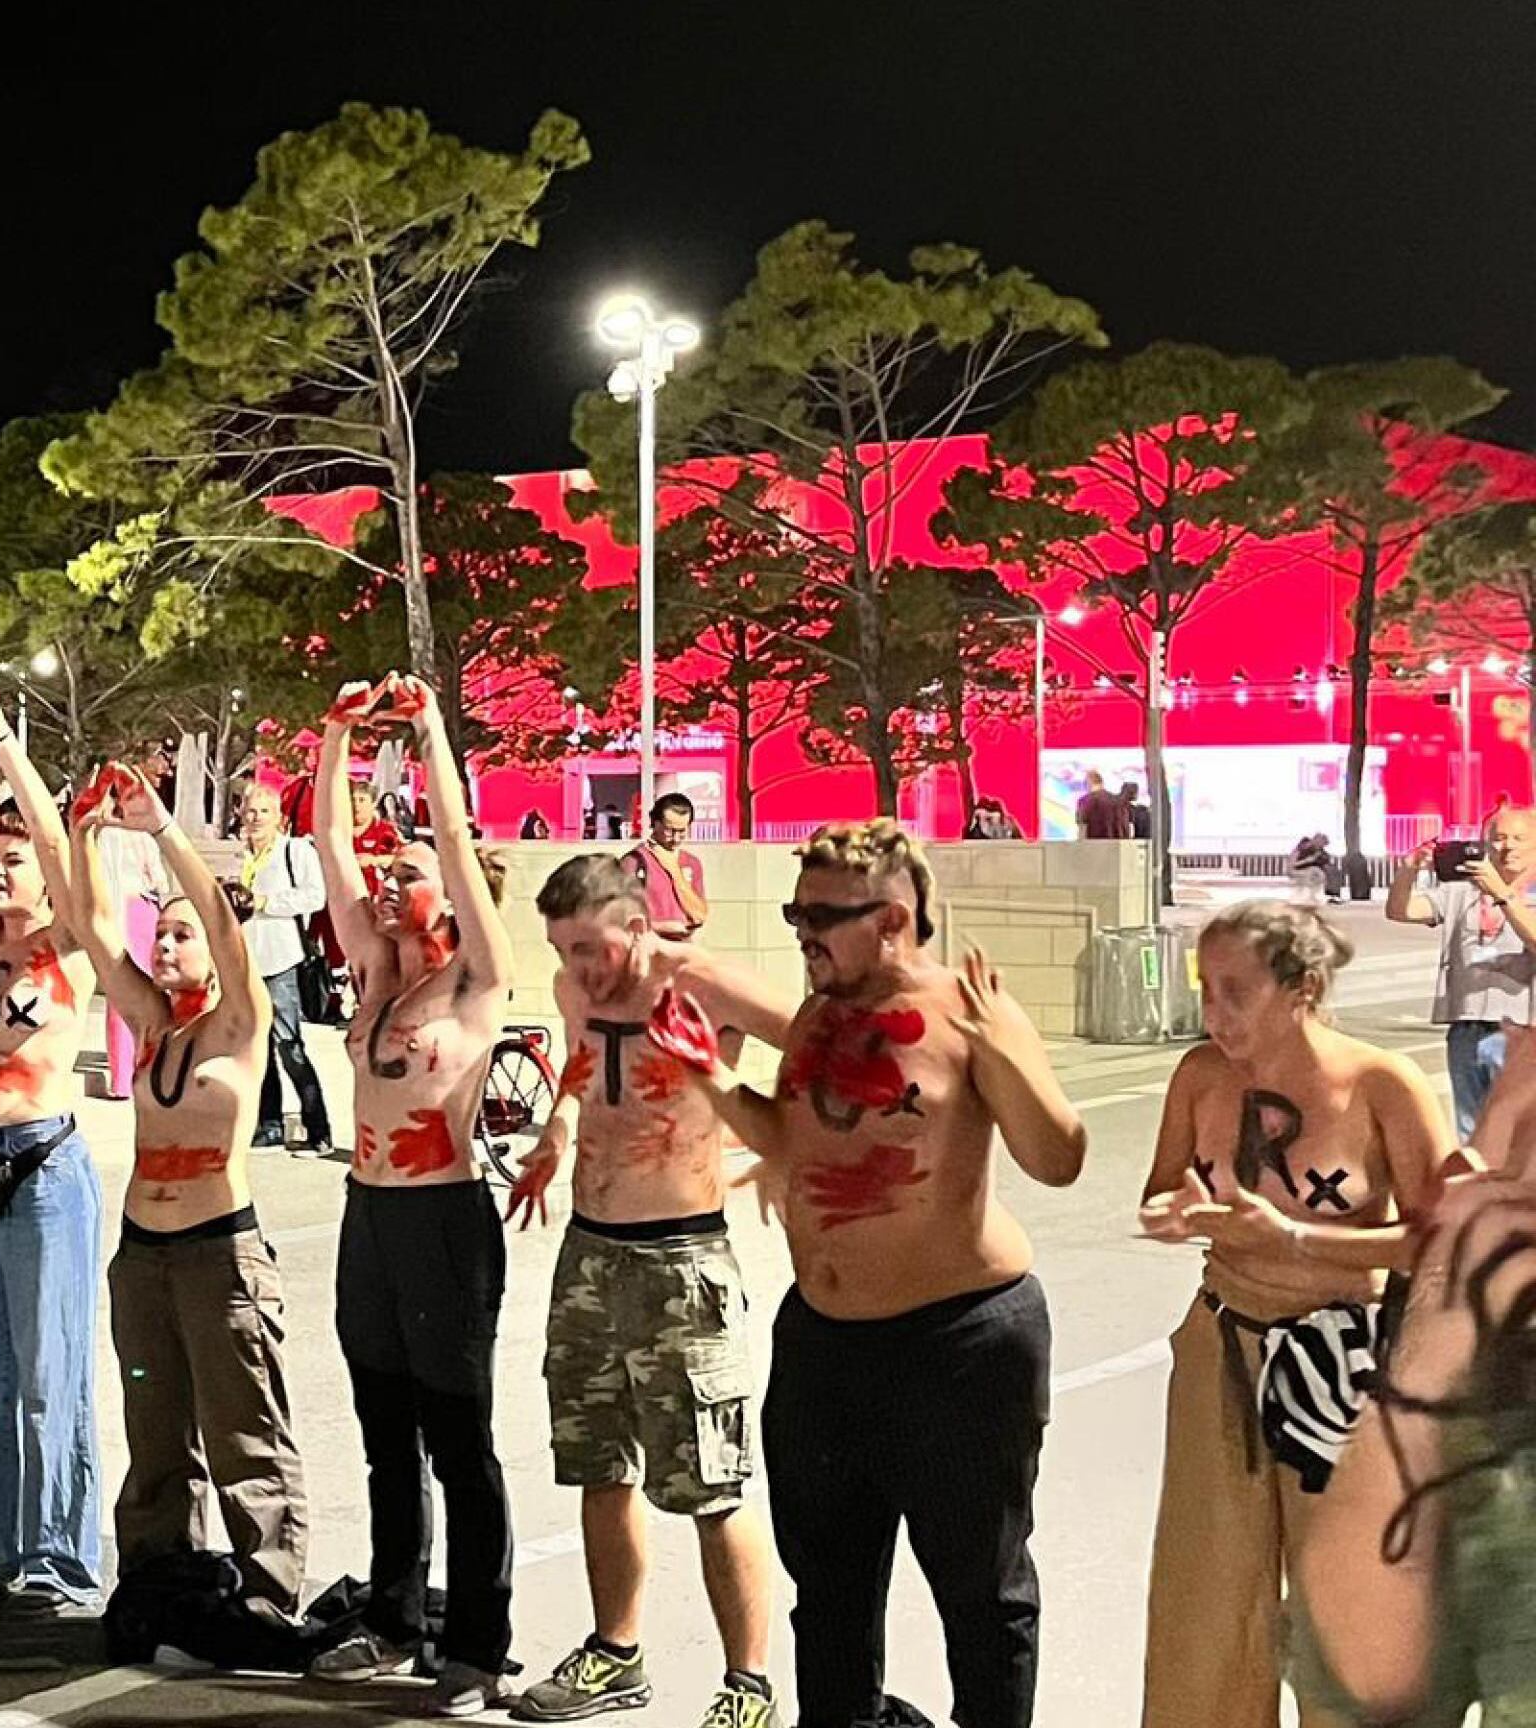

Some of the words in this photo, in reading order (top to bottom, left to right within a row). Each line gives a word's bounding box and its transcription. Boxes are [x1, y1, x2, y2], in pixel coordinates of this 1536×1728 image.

[150, 1030, 195, 1109] U
[586, 1018, 649, 1107] T
[1234, 1089, 1303, 1199] R
